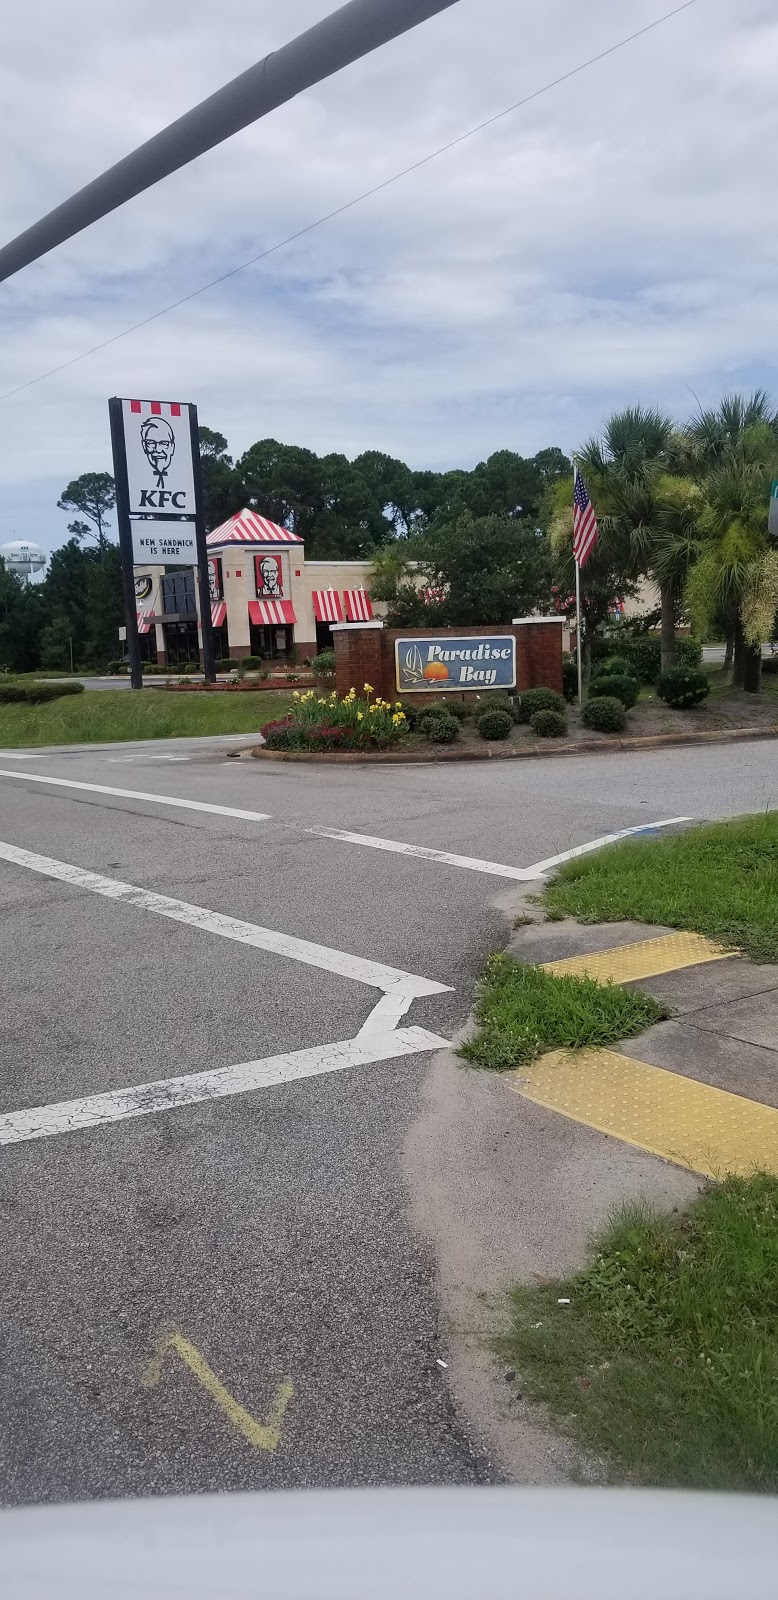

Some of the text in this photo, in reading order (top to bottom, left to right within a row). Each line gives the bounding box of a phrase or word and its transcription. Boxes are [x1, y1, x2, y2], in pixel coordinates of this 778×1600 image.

[139, 489, 186, 509] KFC
[140, 538, 193, 547] NEW SANDWICH
[150, 547, 180, 555] IS HERE
[426, 643, 511, 662] Paradise
[459, 666, 497, 684] Bay
